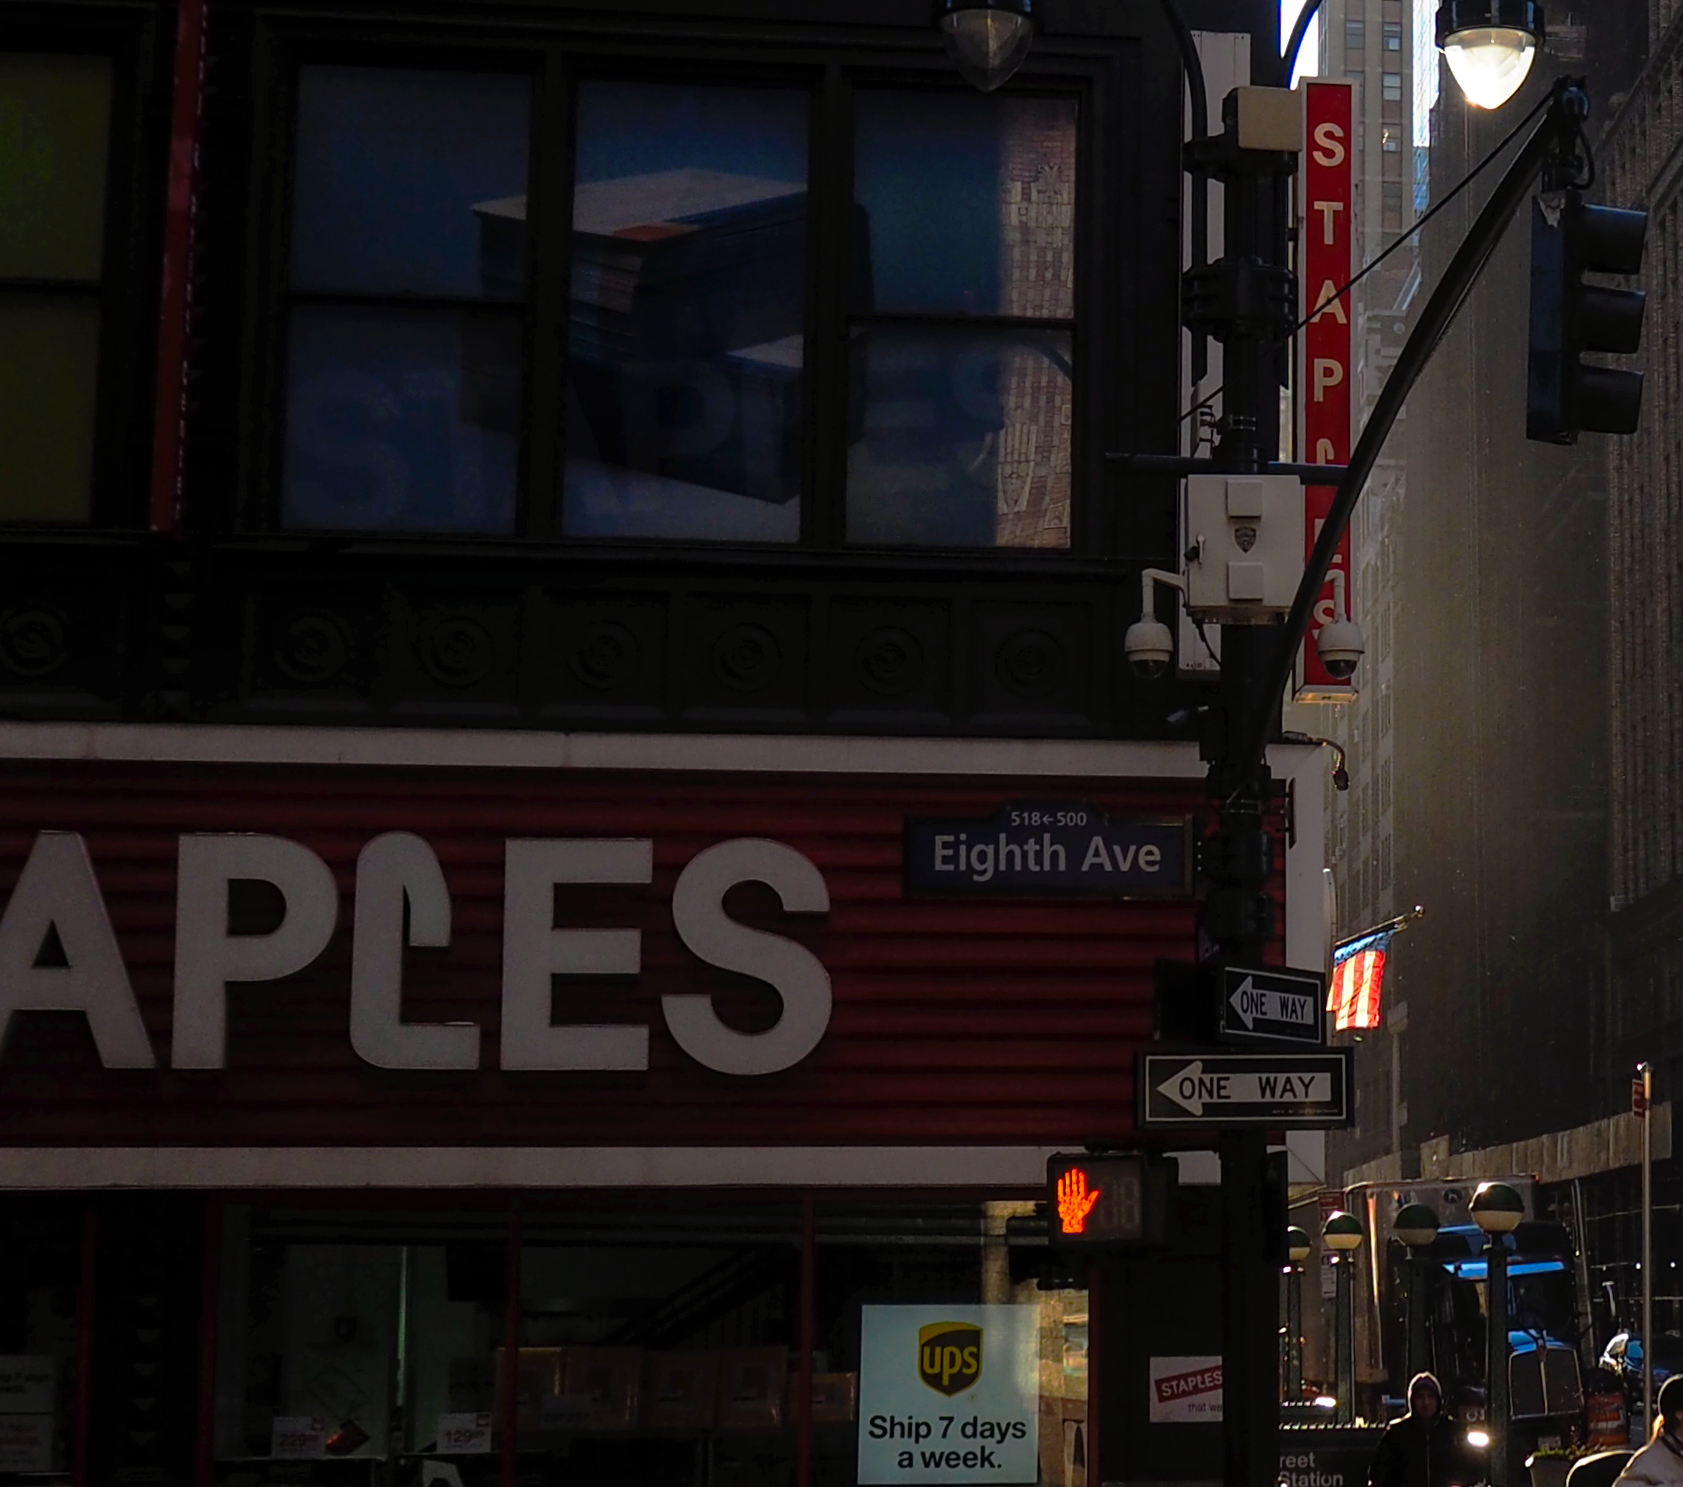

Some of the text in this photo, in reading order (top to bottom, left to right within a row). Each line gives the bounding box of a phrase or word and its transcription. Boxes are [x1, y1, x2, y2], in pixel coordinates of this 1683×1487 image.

[1011, 812, 1087, 827] 518 500
[933, 832, 1161, 882] Eighth Ave
[1240, 990, 1307, 1020] ONE WAY
[1179, 1075, 1315, 1100] ONE WAY
[923, 1346, 978, 1386] ups
[1161, 1369, 1223, 1397] STAPLES
[1188, 1402, 1206, 1413] that
[868, 1415, 1027, 1444] Ship 7 days
[897, 1445, 1002, 1468] a week.
